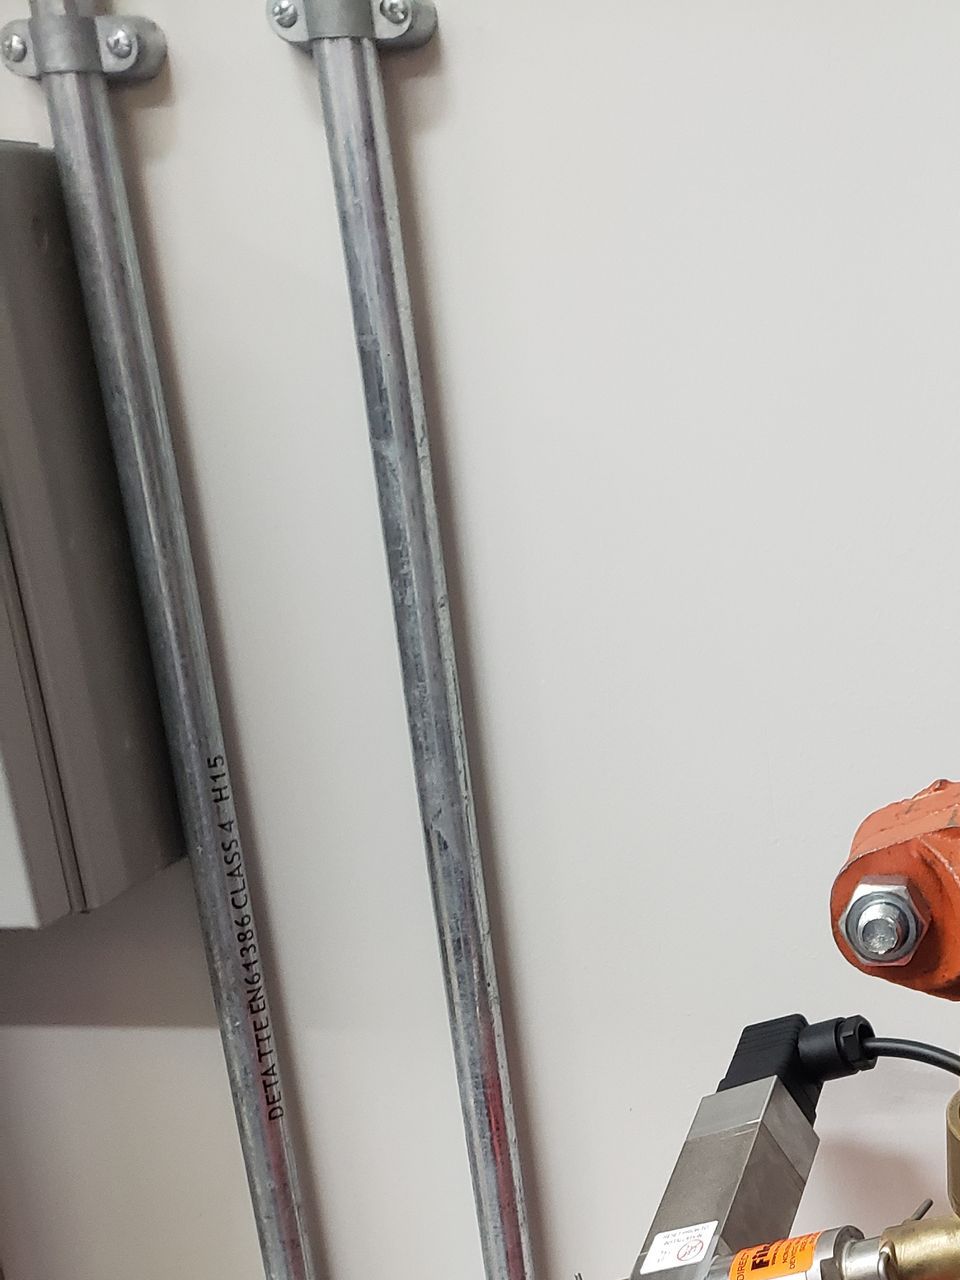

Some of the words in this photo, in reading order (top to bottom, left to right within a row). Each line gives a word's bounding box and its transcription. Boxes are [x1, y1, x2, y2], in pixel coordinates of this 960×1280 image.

[207, 754, 231, 804] H15
[226, 839, 249, 909] CLASS
[237, 914, 266, 1014] EN61386
[261, 1062, 283, 1121] DETA
